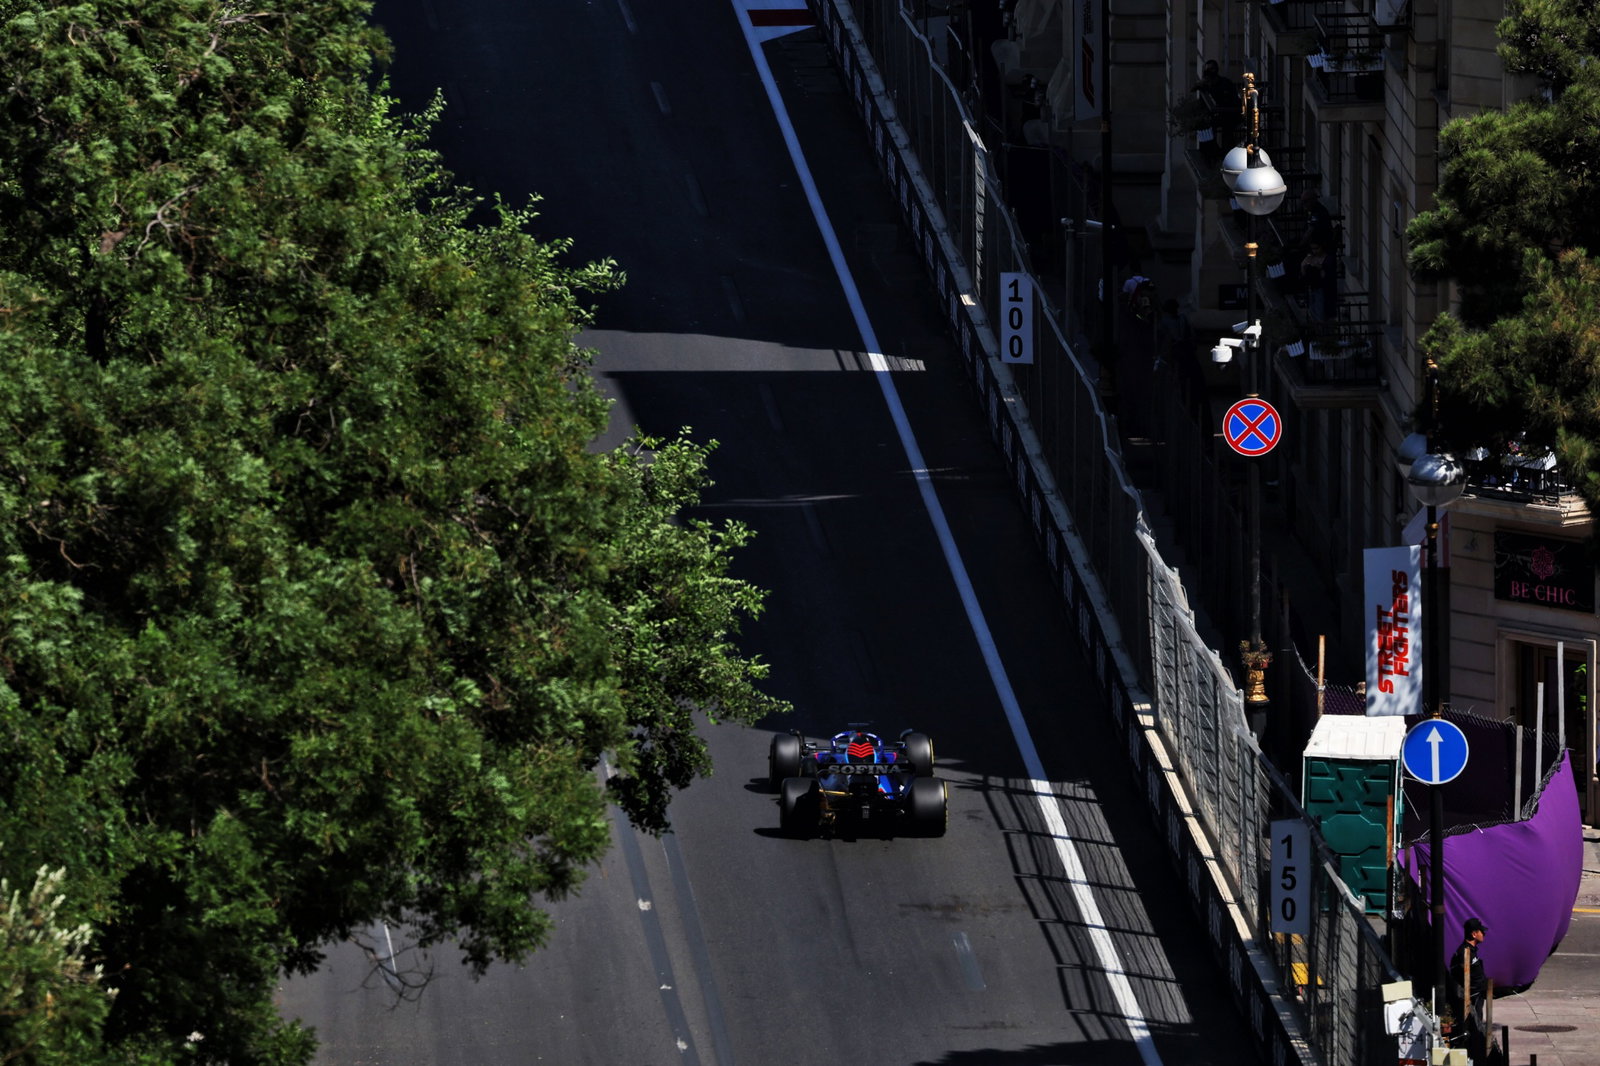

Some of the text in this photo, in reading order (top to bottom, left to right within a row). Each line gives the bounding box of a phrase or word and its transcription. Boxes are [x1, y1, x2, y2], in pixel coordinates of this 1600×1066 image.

[1008, 278, 1023, 358] 100
[1393, 570, 1409, 676] FIGHTERS
[1511, 580, 1576, 606] BE CHIC
[1378, 605, 1394, 693] STREET
[827, 764, 902, 775] SOFINA
[1281, 834, 1297, 922] 150
